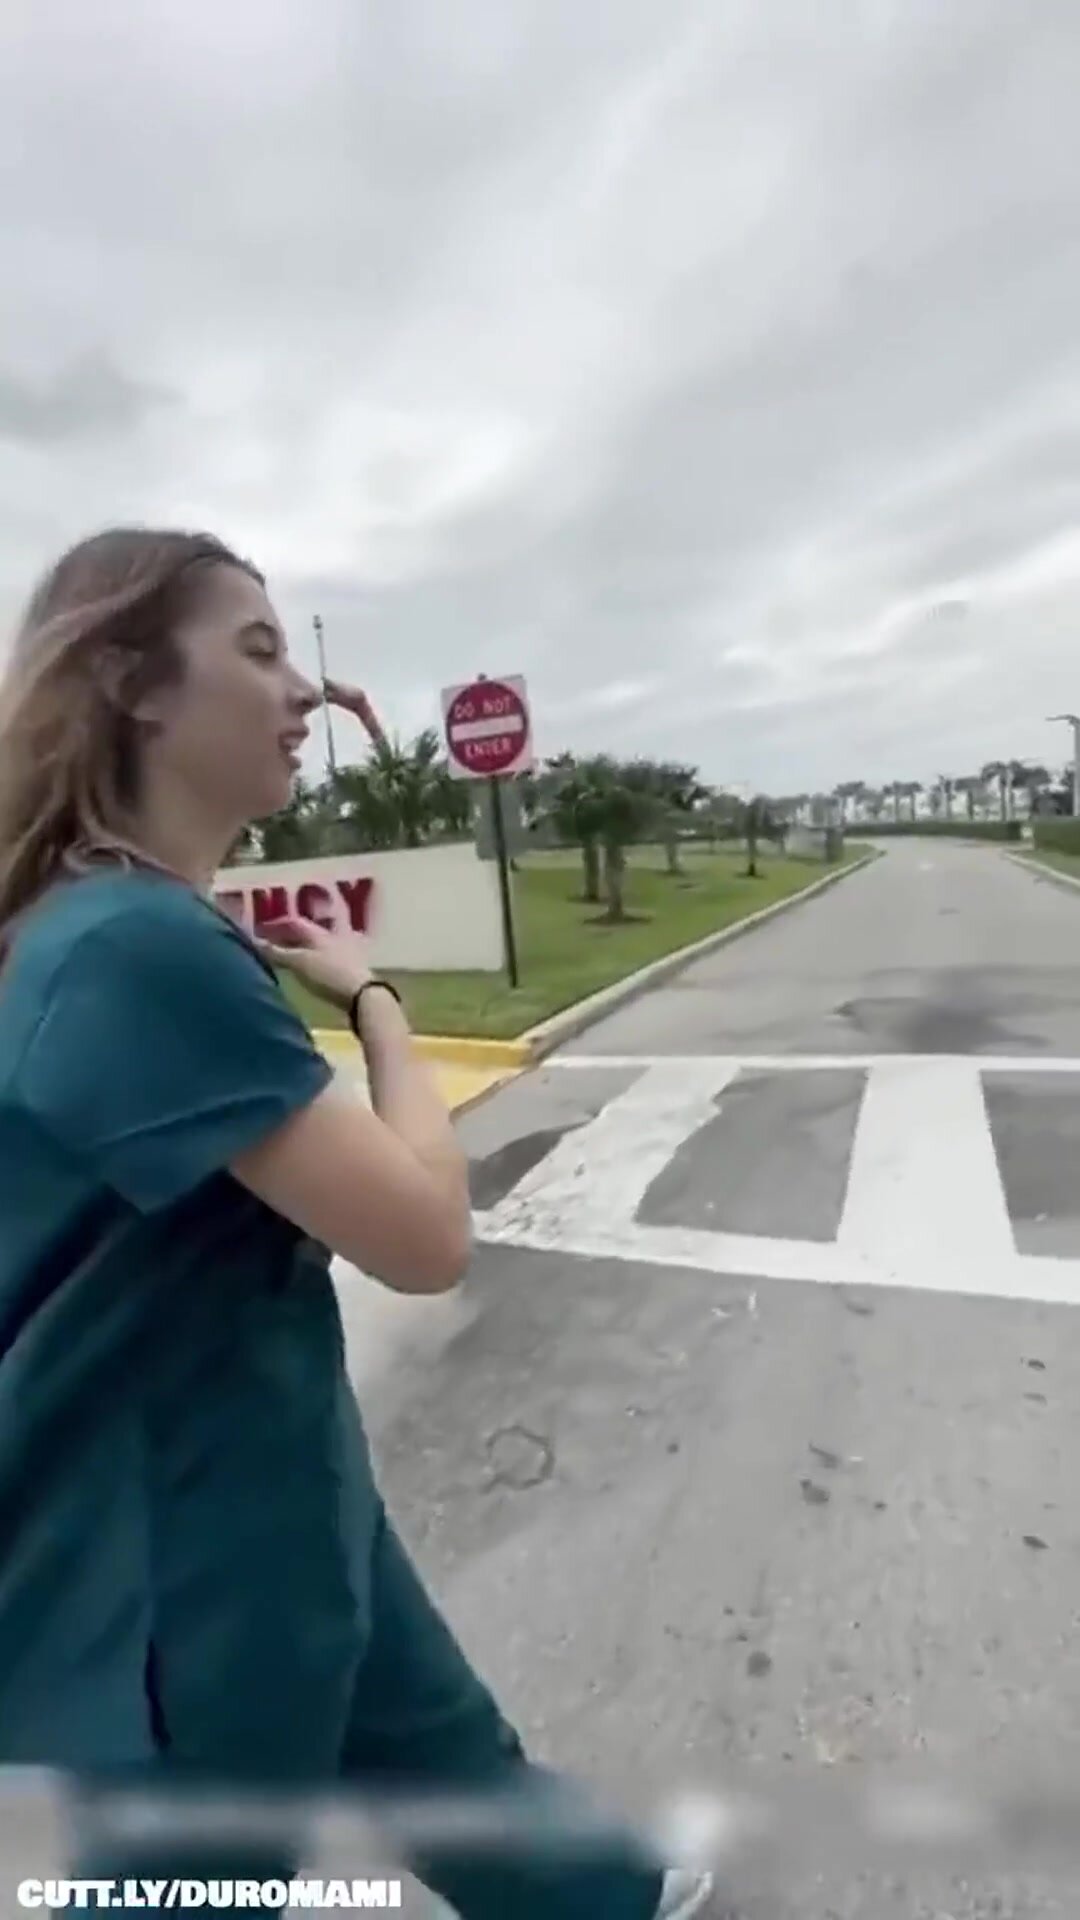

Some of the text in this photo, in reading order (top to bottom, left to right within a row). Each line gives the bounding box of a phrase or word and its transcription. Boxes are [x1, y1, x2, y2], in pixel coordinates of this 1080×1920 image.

[454, 694, 512, 720] DO NOT
[464, 735, 512, 759] ENTER
[215, 877, 374, 936] NCY
